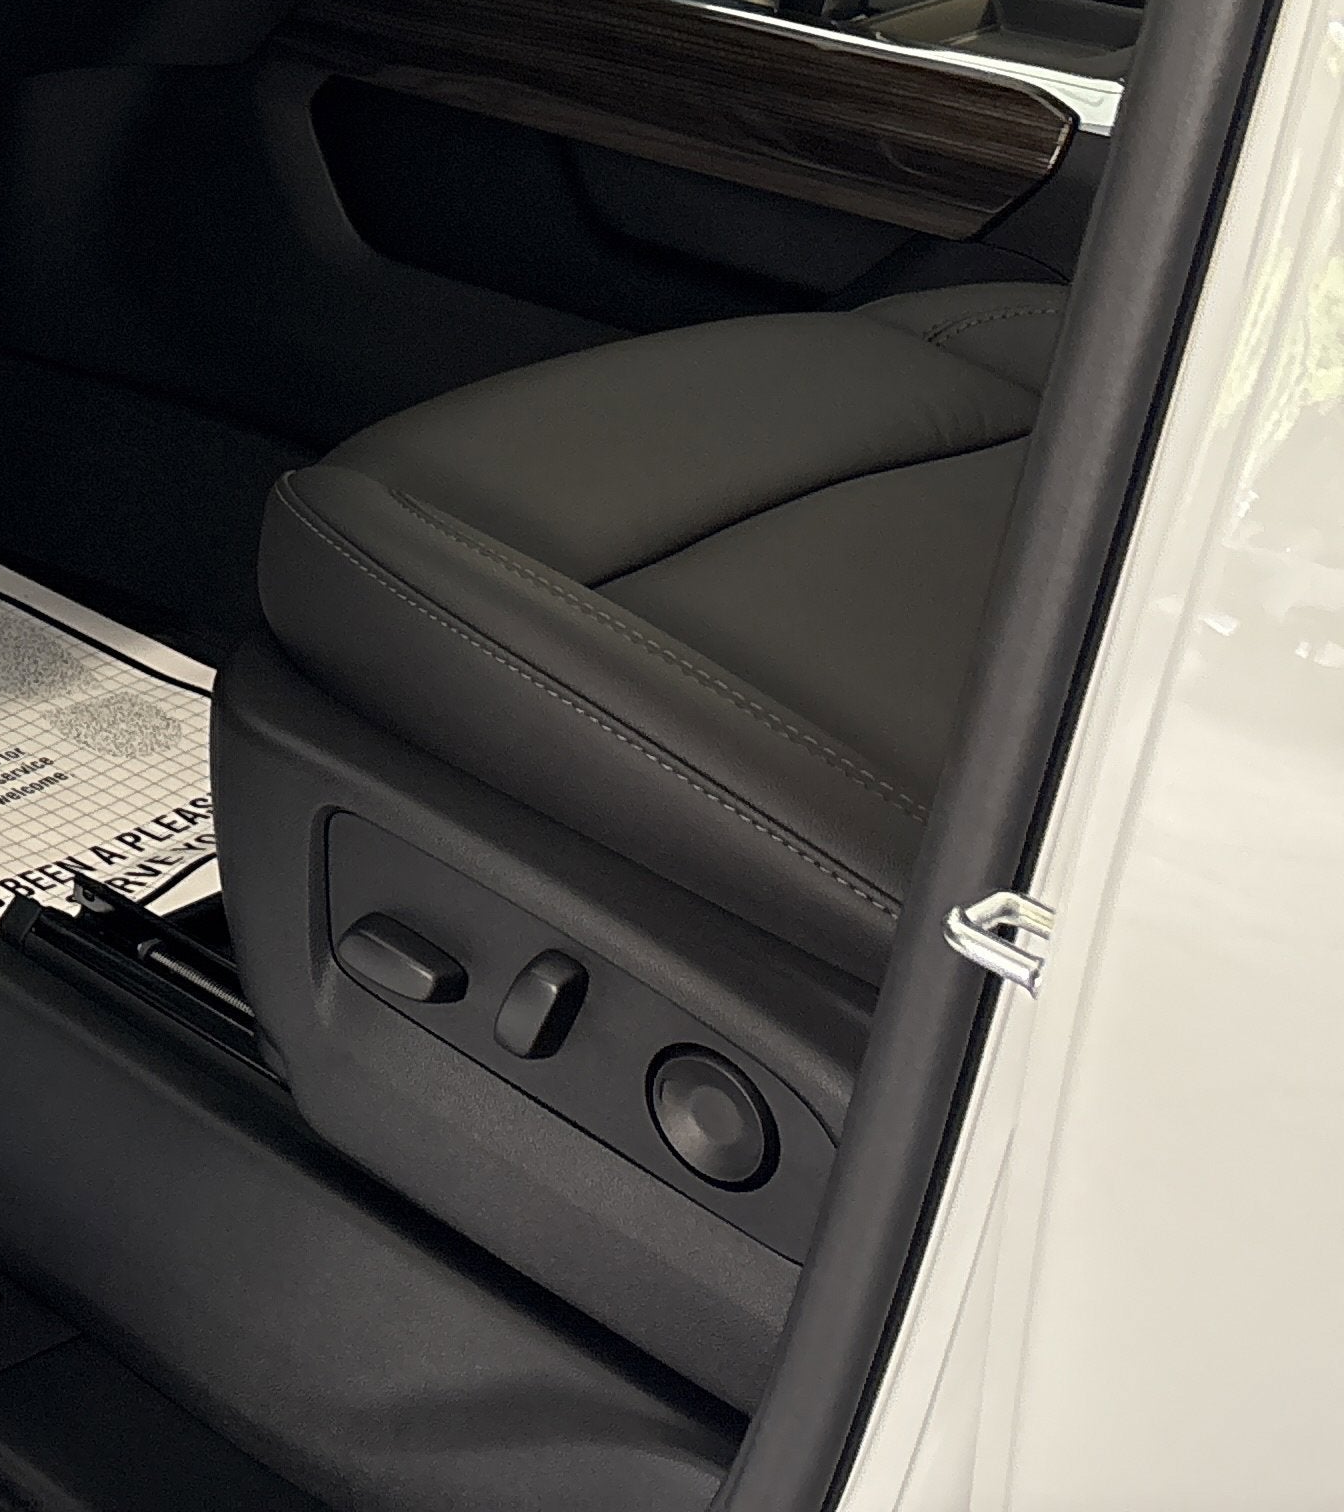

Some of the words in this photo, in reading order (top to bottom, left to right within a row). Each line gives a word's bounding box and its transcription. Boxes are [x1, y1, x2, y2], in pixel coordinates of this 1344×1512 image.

[88, 845, 127, 866] A
[114, 792, 214, 853] PLEAS
[169, 833, 217, 852] YO
